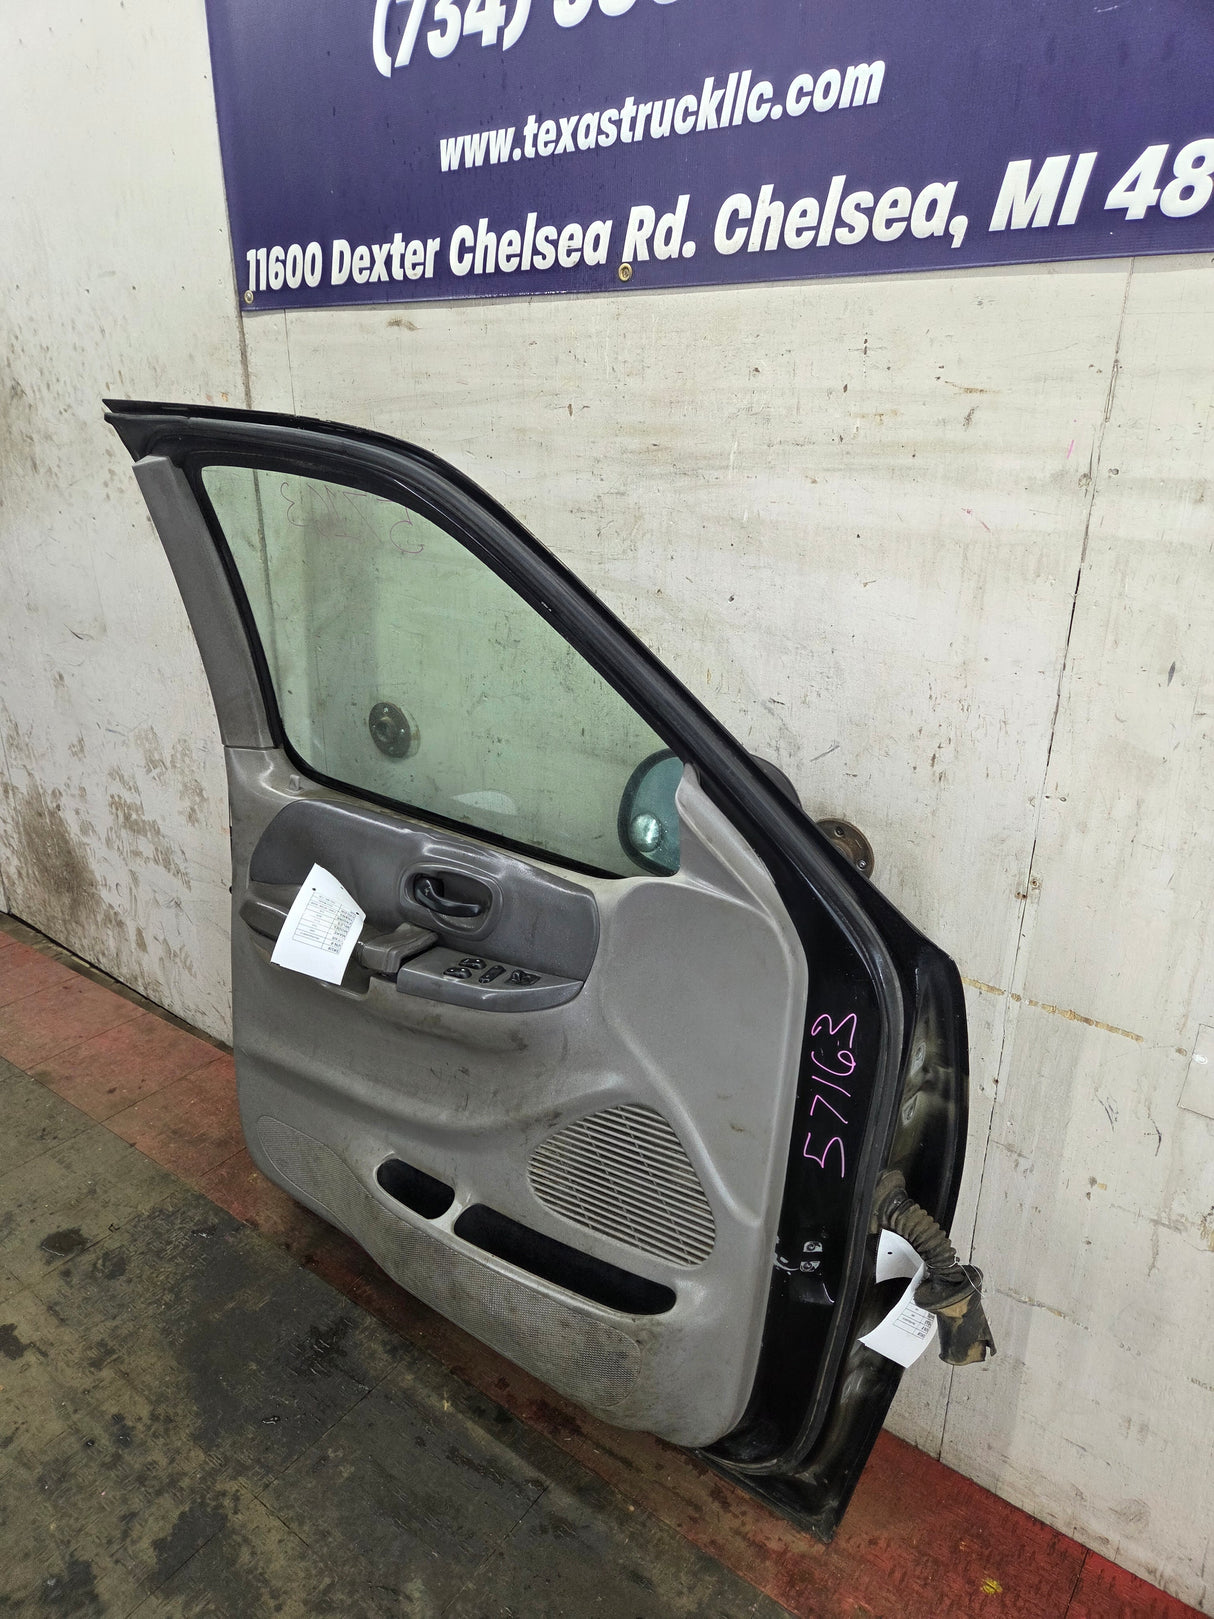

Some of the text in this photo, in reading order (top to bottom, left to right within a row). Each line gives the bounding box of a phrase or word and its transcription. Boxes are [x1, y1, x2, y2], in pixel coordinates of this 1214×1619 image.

[440, 60, 885, 172] www.texastruckllc.com
[246, 241, 323, 292] 11600
[331, 233, 440, 285] Dexter
[450, 212, 613, 277] Chelsea
[622, 194, 697, 263] Rd.
[714, 175, 968, 256] Chelsea,
[989, 152, 1097, 232] MI
[804, 1013, 857, 1178] 57163
